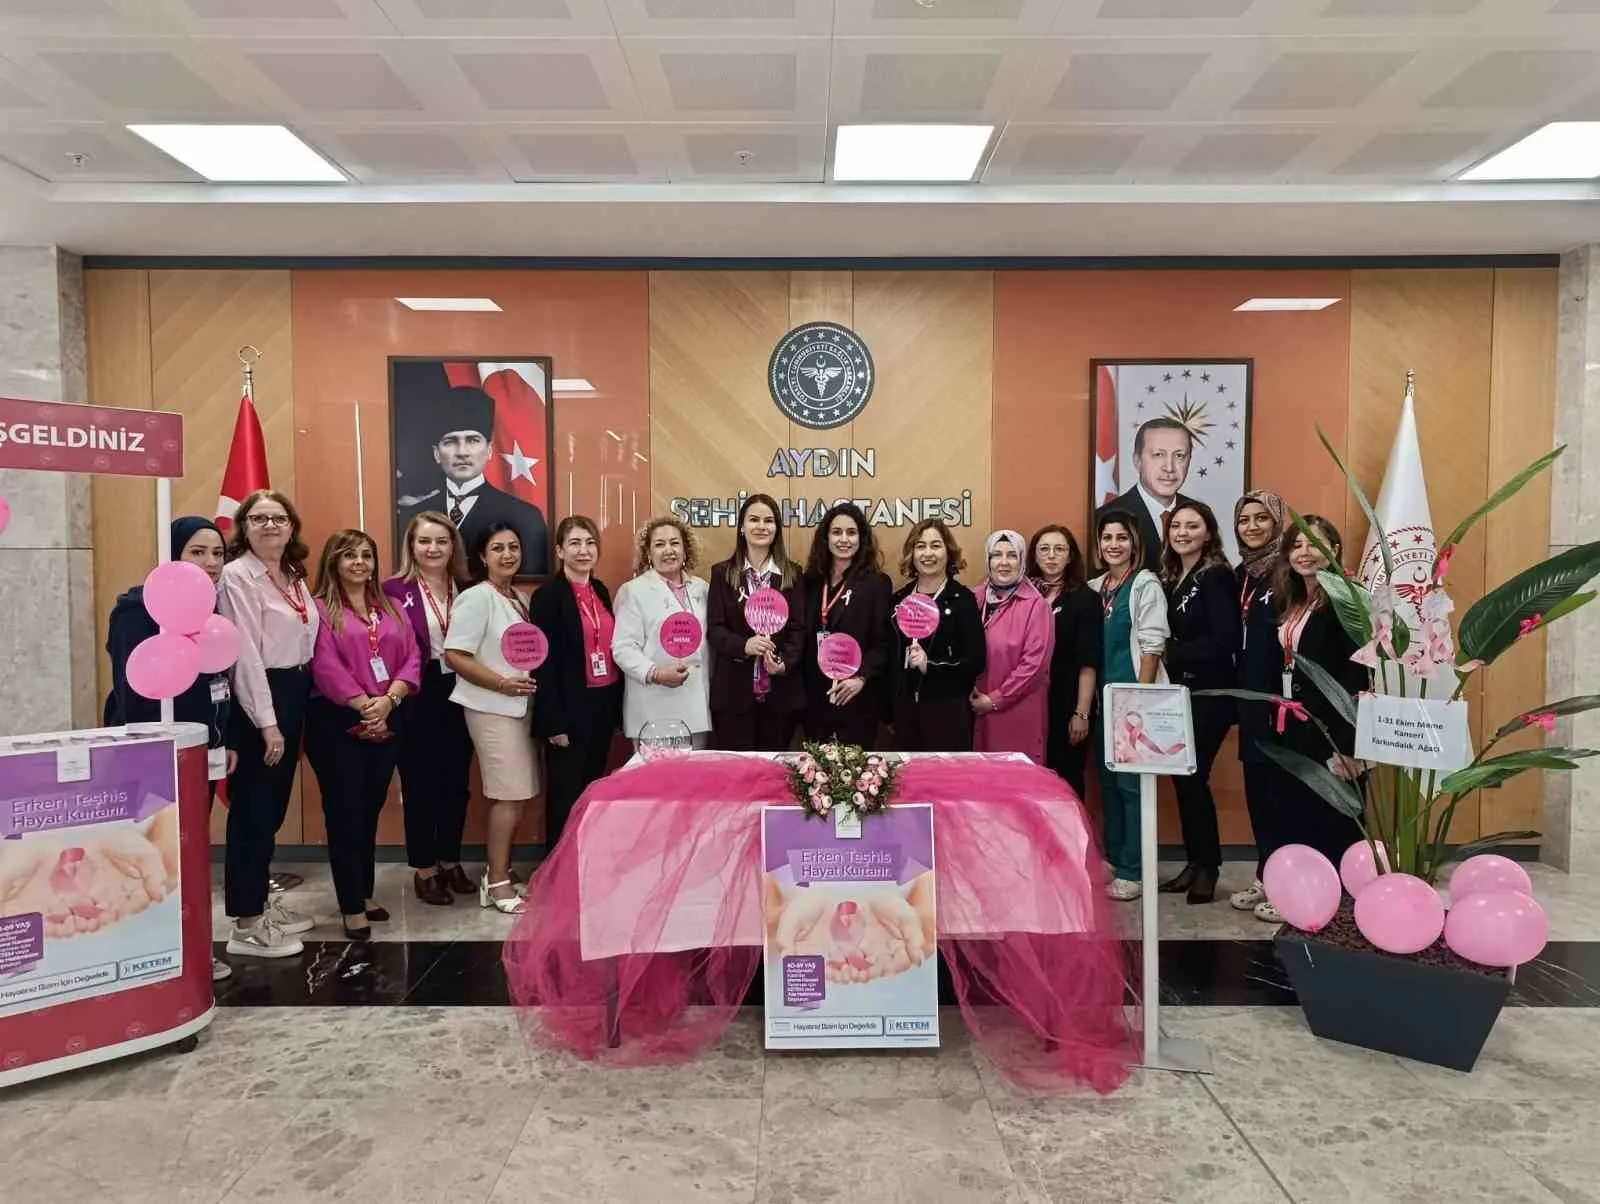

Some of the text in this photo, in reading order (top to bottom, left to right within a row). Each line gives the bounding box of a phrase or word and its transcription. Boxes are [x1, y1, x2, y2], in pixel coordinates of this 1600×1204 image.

[767, 448, 876, 478] AYDIN
[781, 489, 972, 529] HATANESİ
[1395, 718, 1415, 727] Ekim
[1417, 720, 1443, 730] Meme
[1394, 729, 1424, 739] Kanseri
[12, 799, 67, 815] Erken
[12, 815, 63, 831] Hayat
[802, 850, 843, 864] Erken
[802, 865, 839, 879] Hayat
[132, 956, 172, 972] KETEM
[896, 1021, 929, 1030] KETEM
